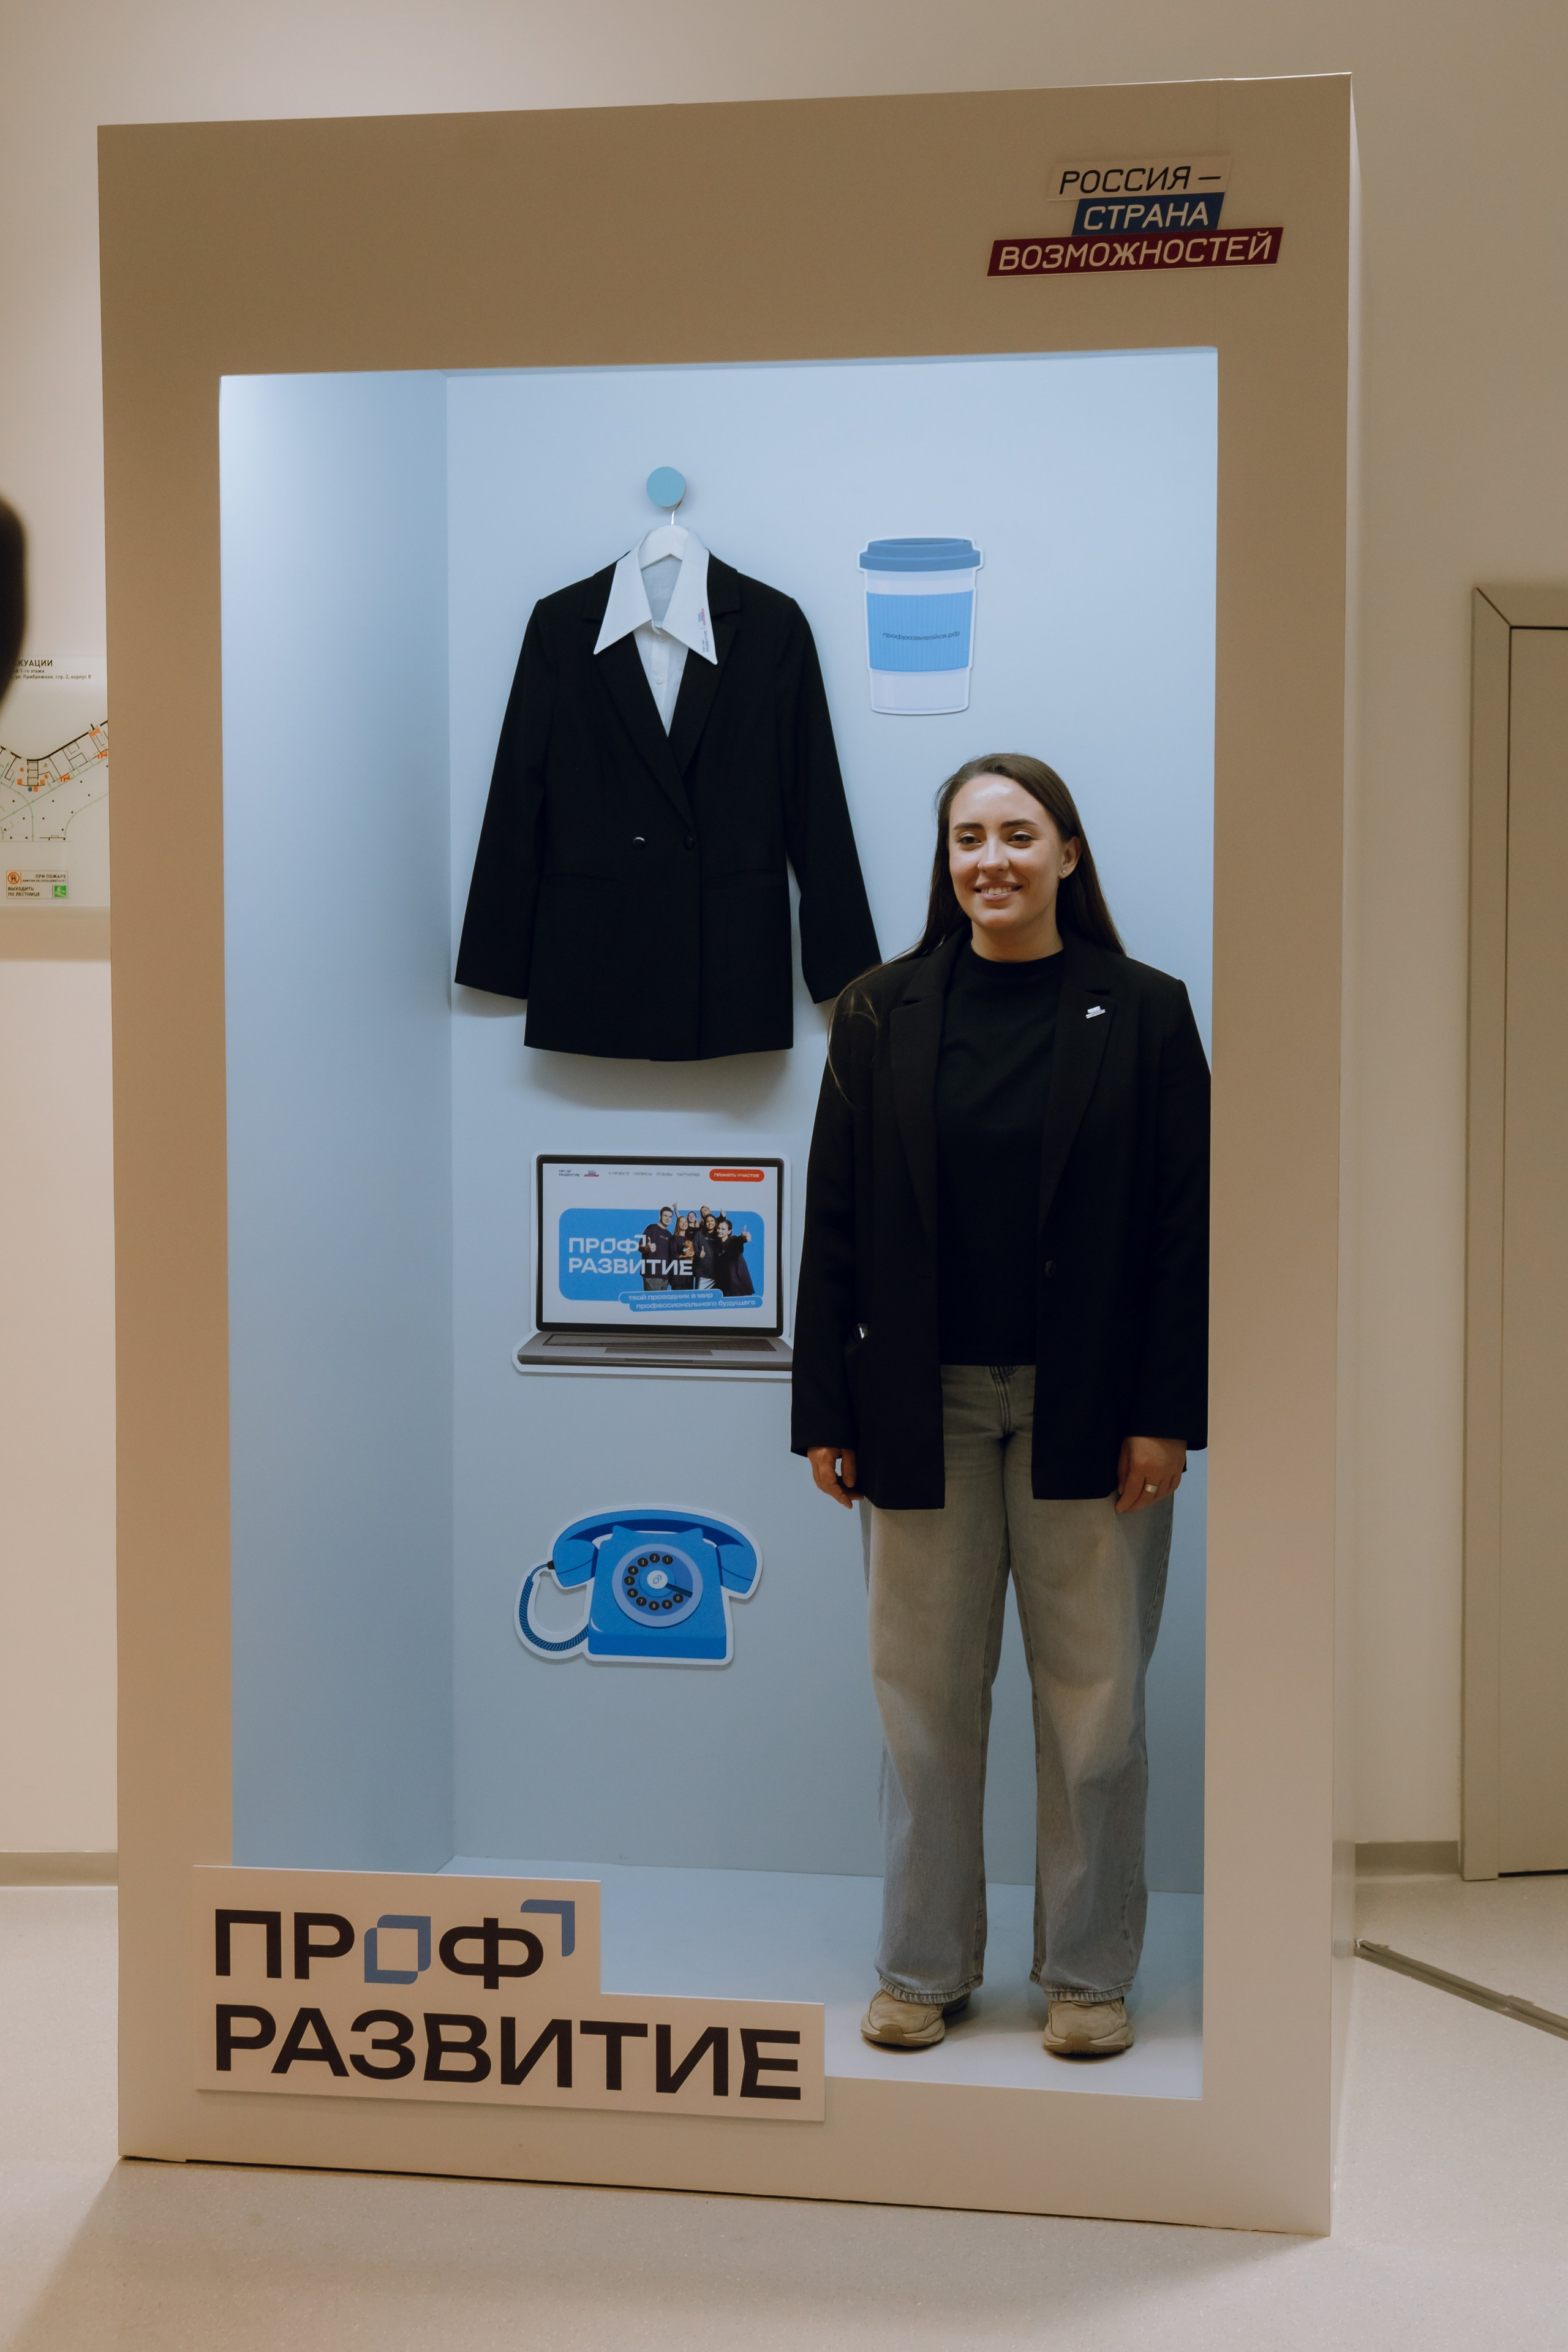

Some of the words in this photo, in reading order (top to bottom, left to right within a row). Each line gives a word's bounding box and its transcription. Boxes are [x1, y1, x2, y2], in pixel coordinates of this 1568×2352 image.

[1059, 166, 1191, 195] РОССИЯ
[1084, 202, 1209, 231] СТРАНА
[998, 231, 1273, 271] ВОЗМОЖНОСТЕЙ
[882, 631, 960, 641] профразвивайся.рф
[18, 659, 53, 668] КУАЦИИ
[568, 1237, 641, 1254] ПРОФ
[568, 1257, 693, 1276] РАЗВИТИЕ
[636, 1301, 717, 1310] профессионального
[215, 1908, 545, 1990] ПРОФ
[216, 2003, 802, 2100] РАЗВИТИЕ
